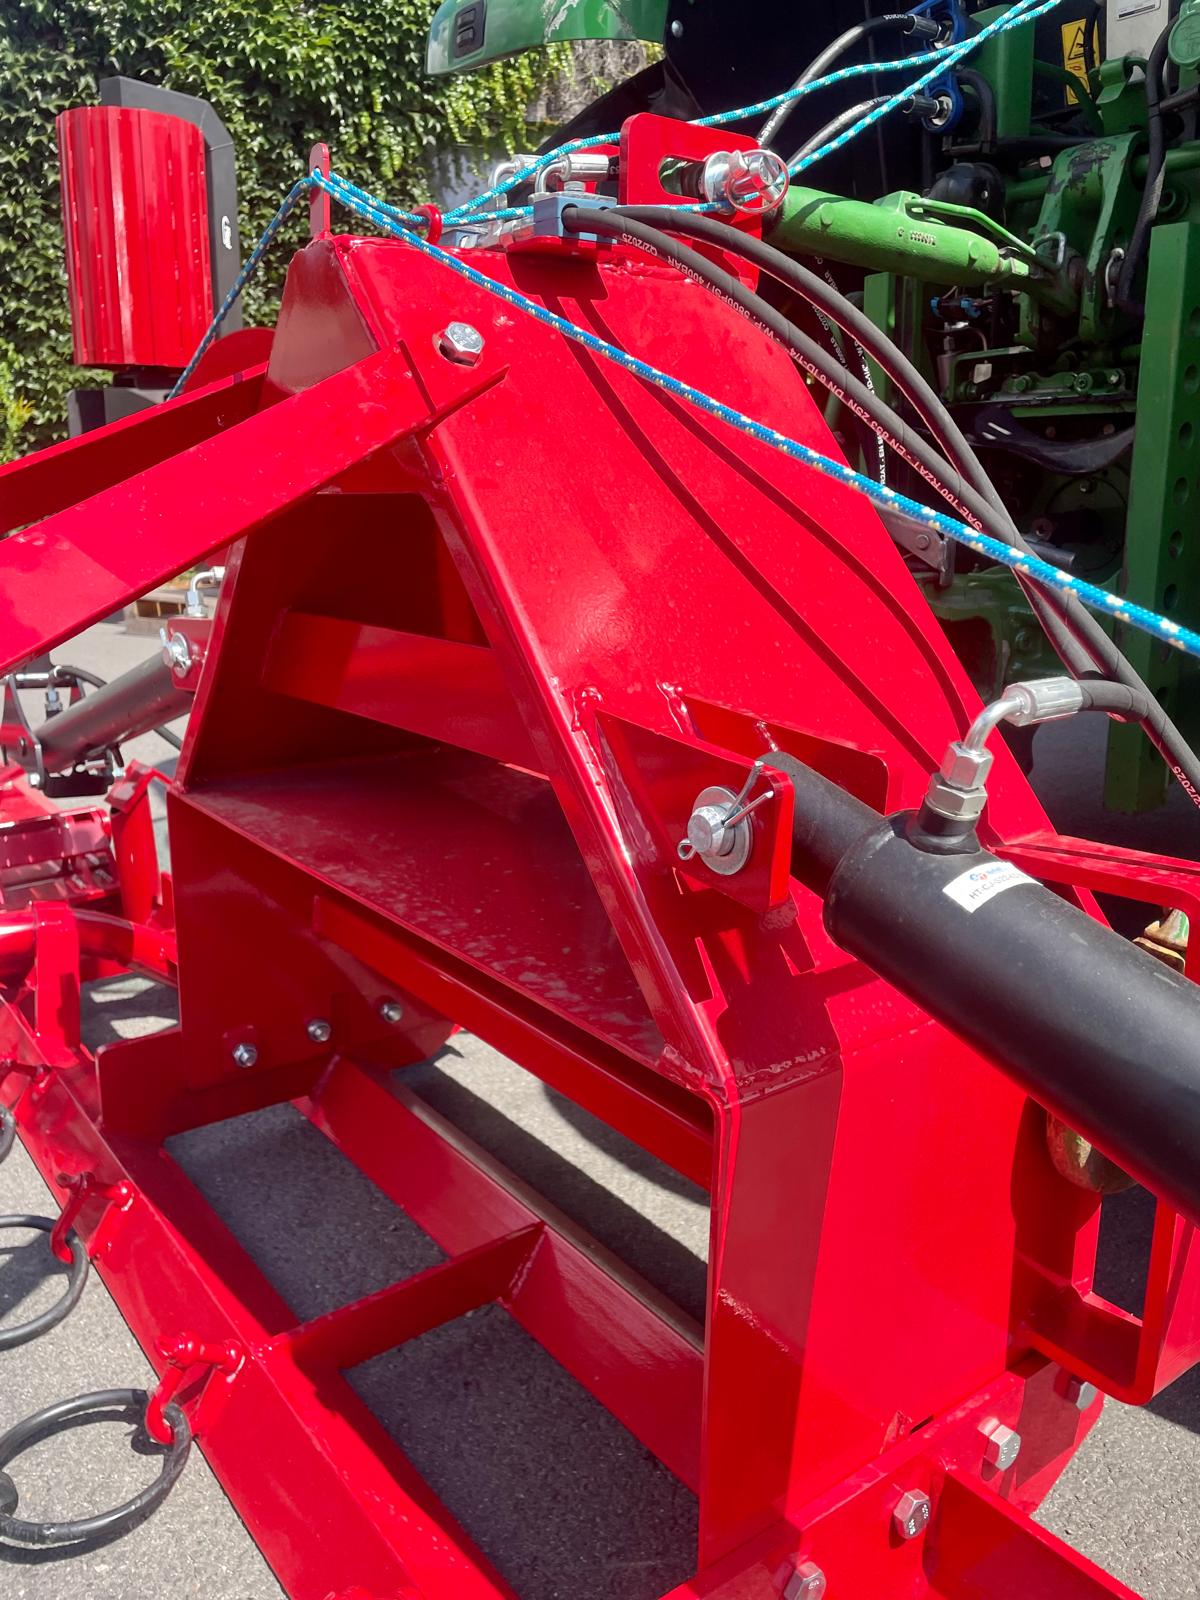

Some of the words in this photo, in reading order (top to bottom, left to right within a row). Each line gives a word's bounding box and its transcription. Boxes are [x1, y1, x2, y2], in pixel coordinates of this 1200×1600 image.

[622, 233, 658, 257] Q2/2025
[828, 381, 845, 399] DN
[848, 399, 870, 421] 2SN
[871, 420, 889, 439] 853
[889, 438, 906, 456] EN
[914, 462, 941, 490] R2AT
[941, 487, 959, 507] 100
[959, 506, 983, 530] SAE
[1173, 766, 1200, 809] 2/2025
